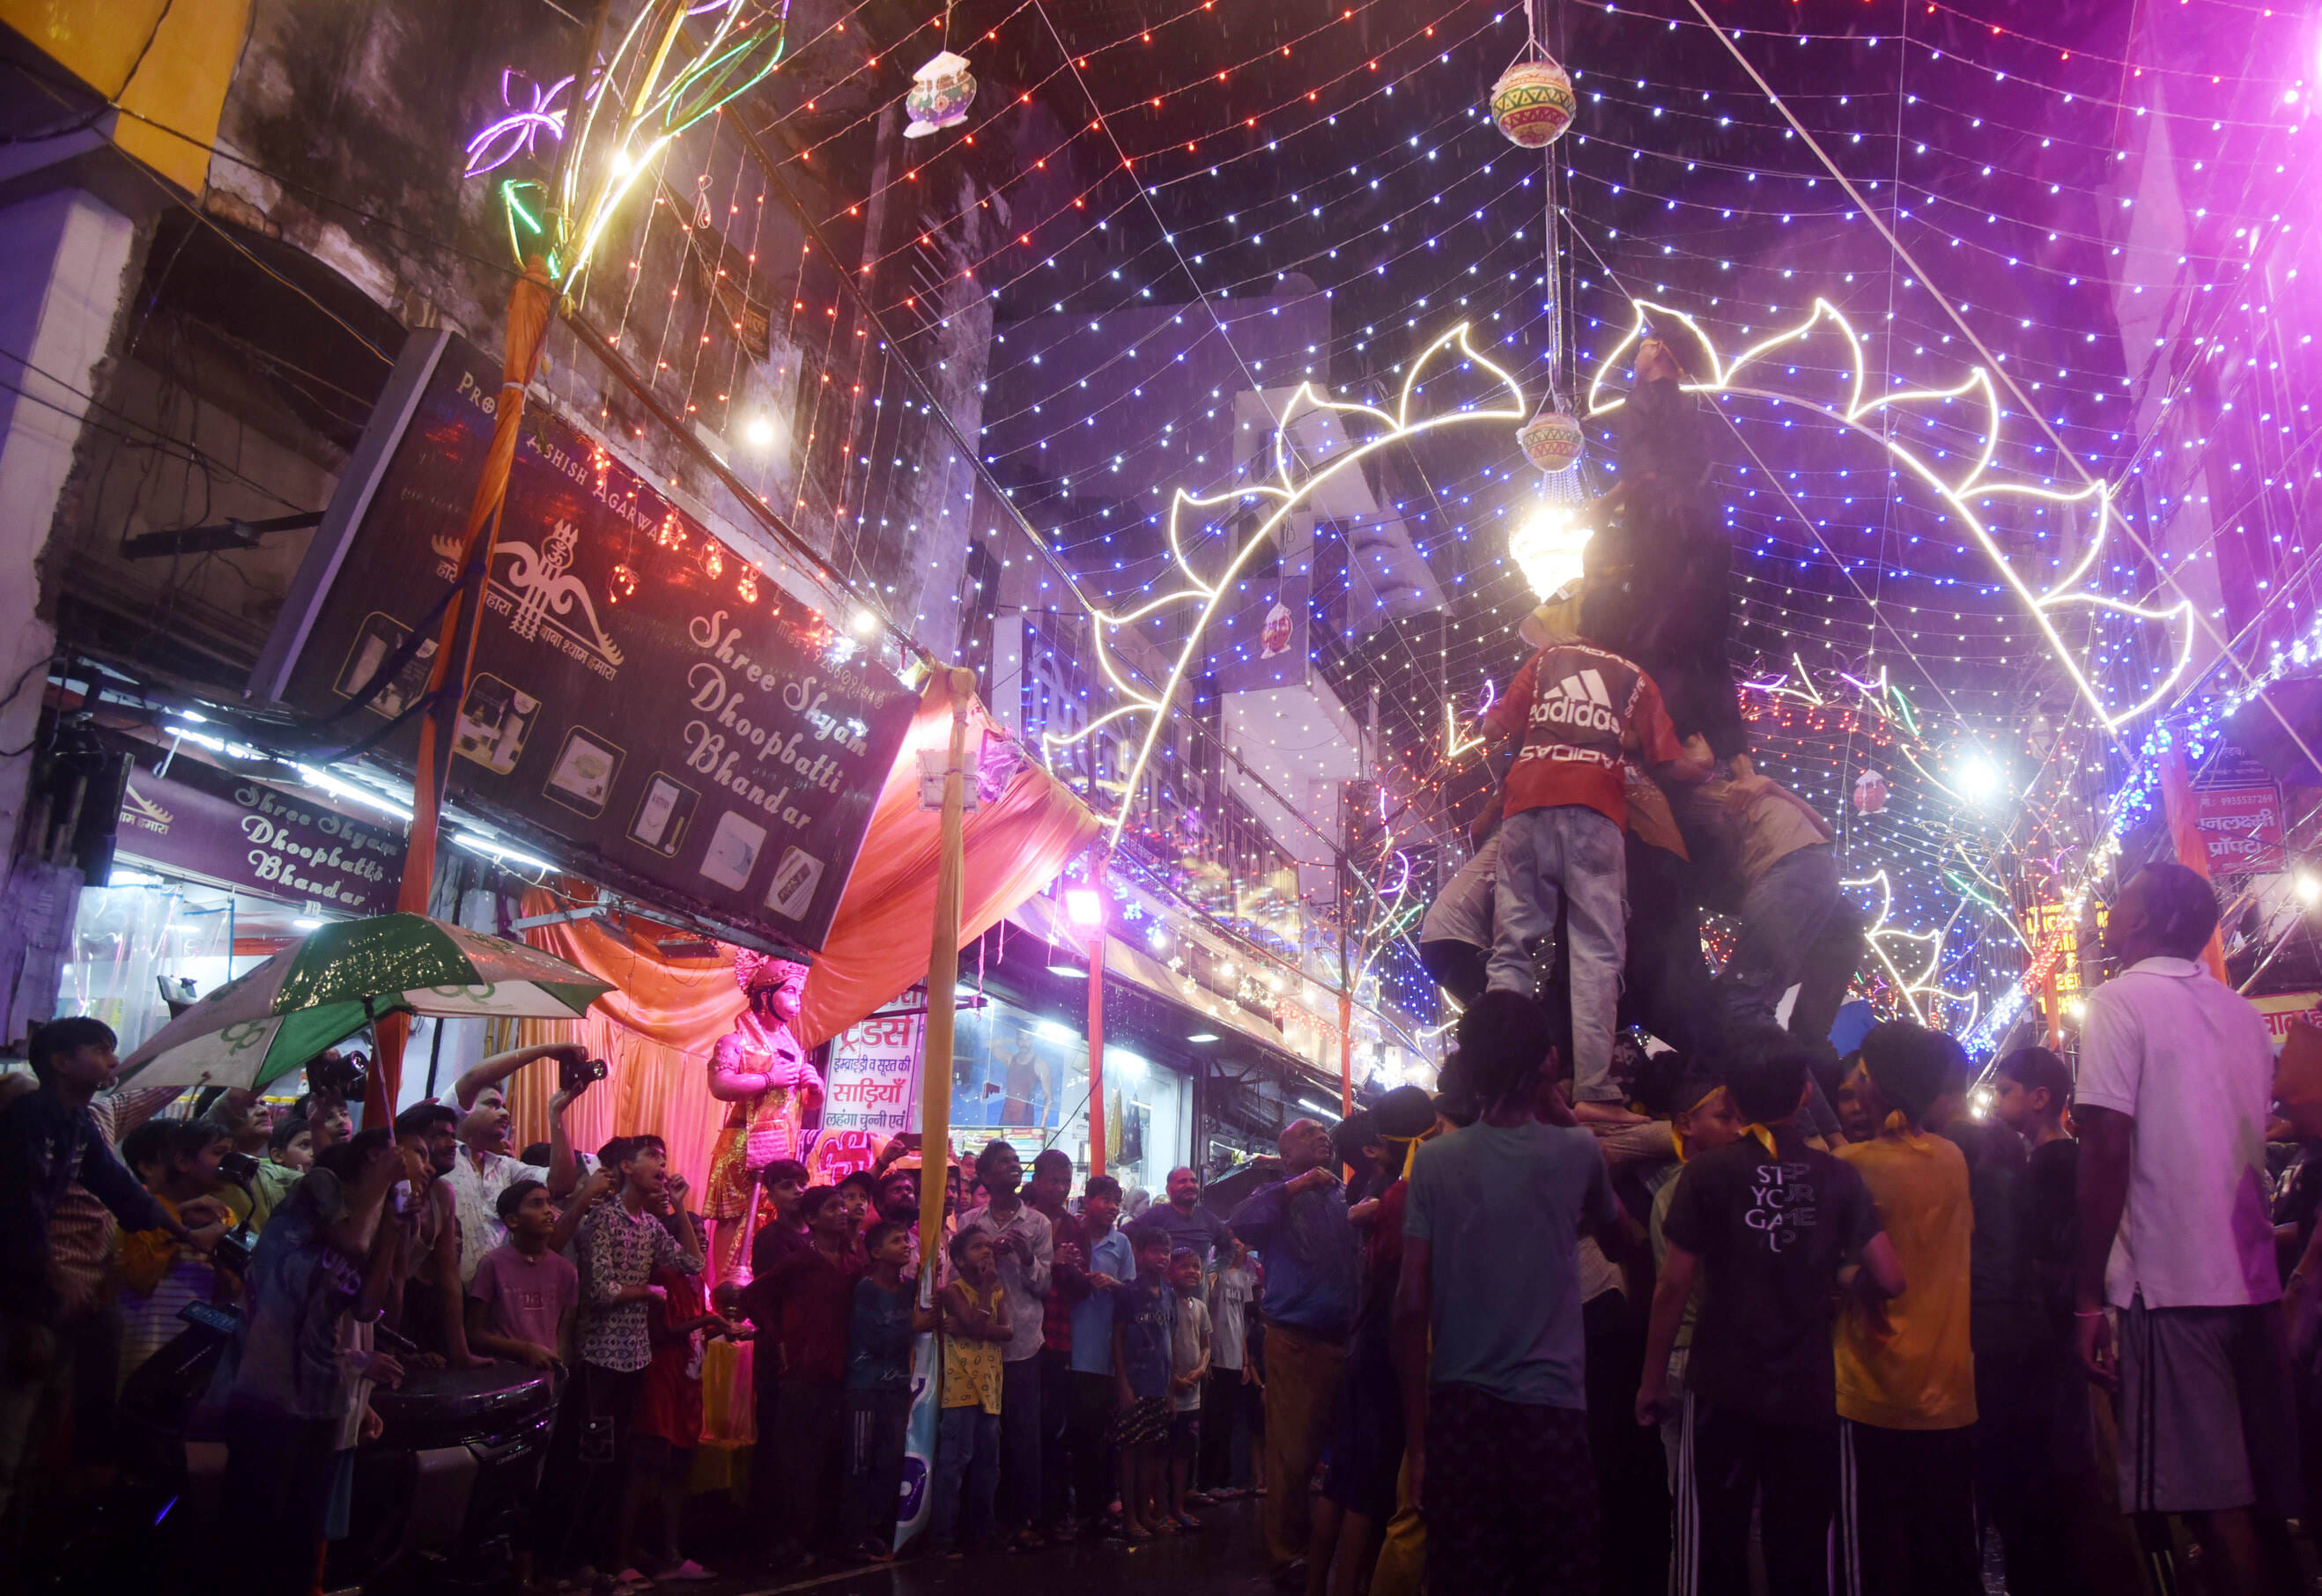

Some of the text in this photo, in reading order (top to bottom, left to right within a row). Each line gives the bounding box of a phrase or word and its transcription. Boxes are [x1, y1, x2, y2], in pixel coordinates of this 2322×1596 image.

[456, 370, 499, 421] PRO
[526, 435, 589, 485] ASHISH
[486, 591, 513, 617] हारा
[690, 610, 868, 757] Shree Shyam
[688, 662, 844, 794] Dhoopbatti
[1535, 696, 1621, 735] adidas
[684, 720, 811, 829] Bhandar
[235, 785, 397, 856] Shree Shyam
[241, 815, 383, 882] Dhoopbatti
[248, 849, 366, 906] Bhandar
[833, 1077, 906, 1109] साड़ियाँ
[869, 1059, 876, 1071] व
[877, 1059, 897, 1076] सूरत
[898, 1055, 911, 1072] की
[826, 1109, 906, 1132] लहंगा चुन्नी एवं
